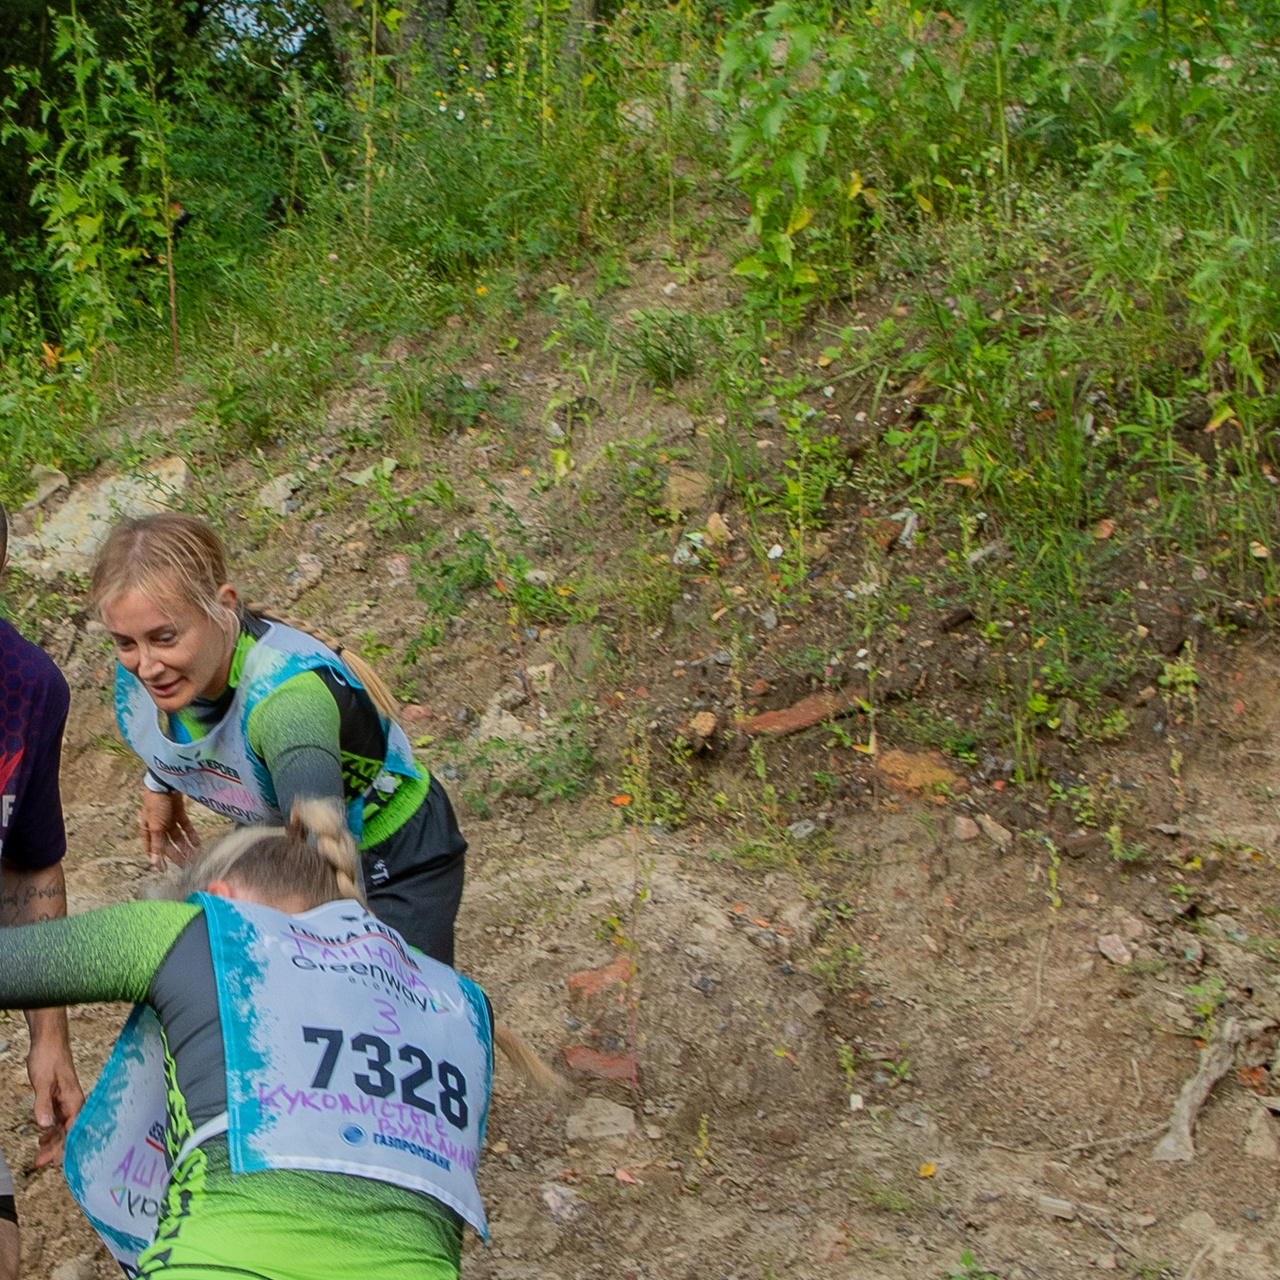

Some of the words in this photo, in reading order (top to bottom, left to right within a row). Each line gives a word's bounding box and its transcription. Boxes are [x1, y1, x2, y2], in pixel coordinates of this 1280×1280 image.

[291, 954, 427, 1012] Greenway
[301, 1025, 468, 1131] 7328
[373, 1133, 452, 1173] ГАЗПРОМБАНК
